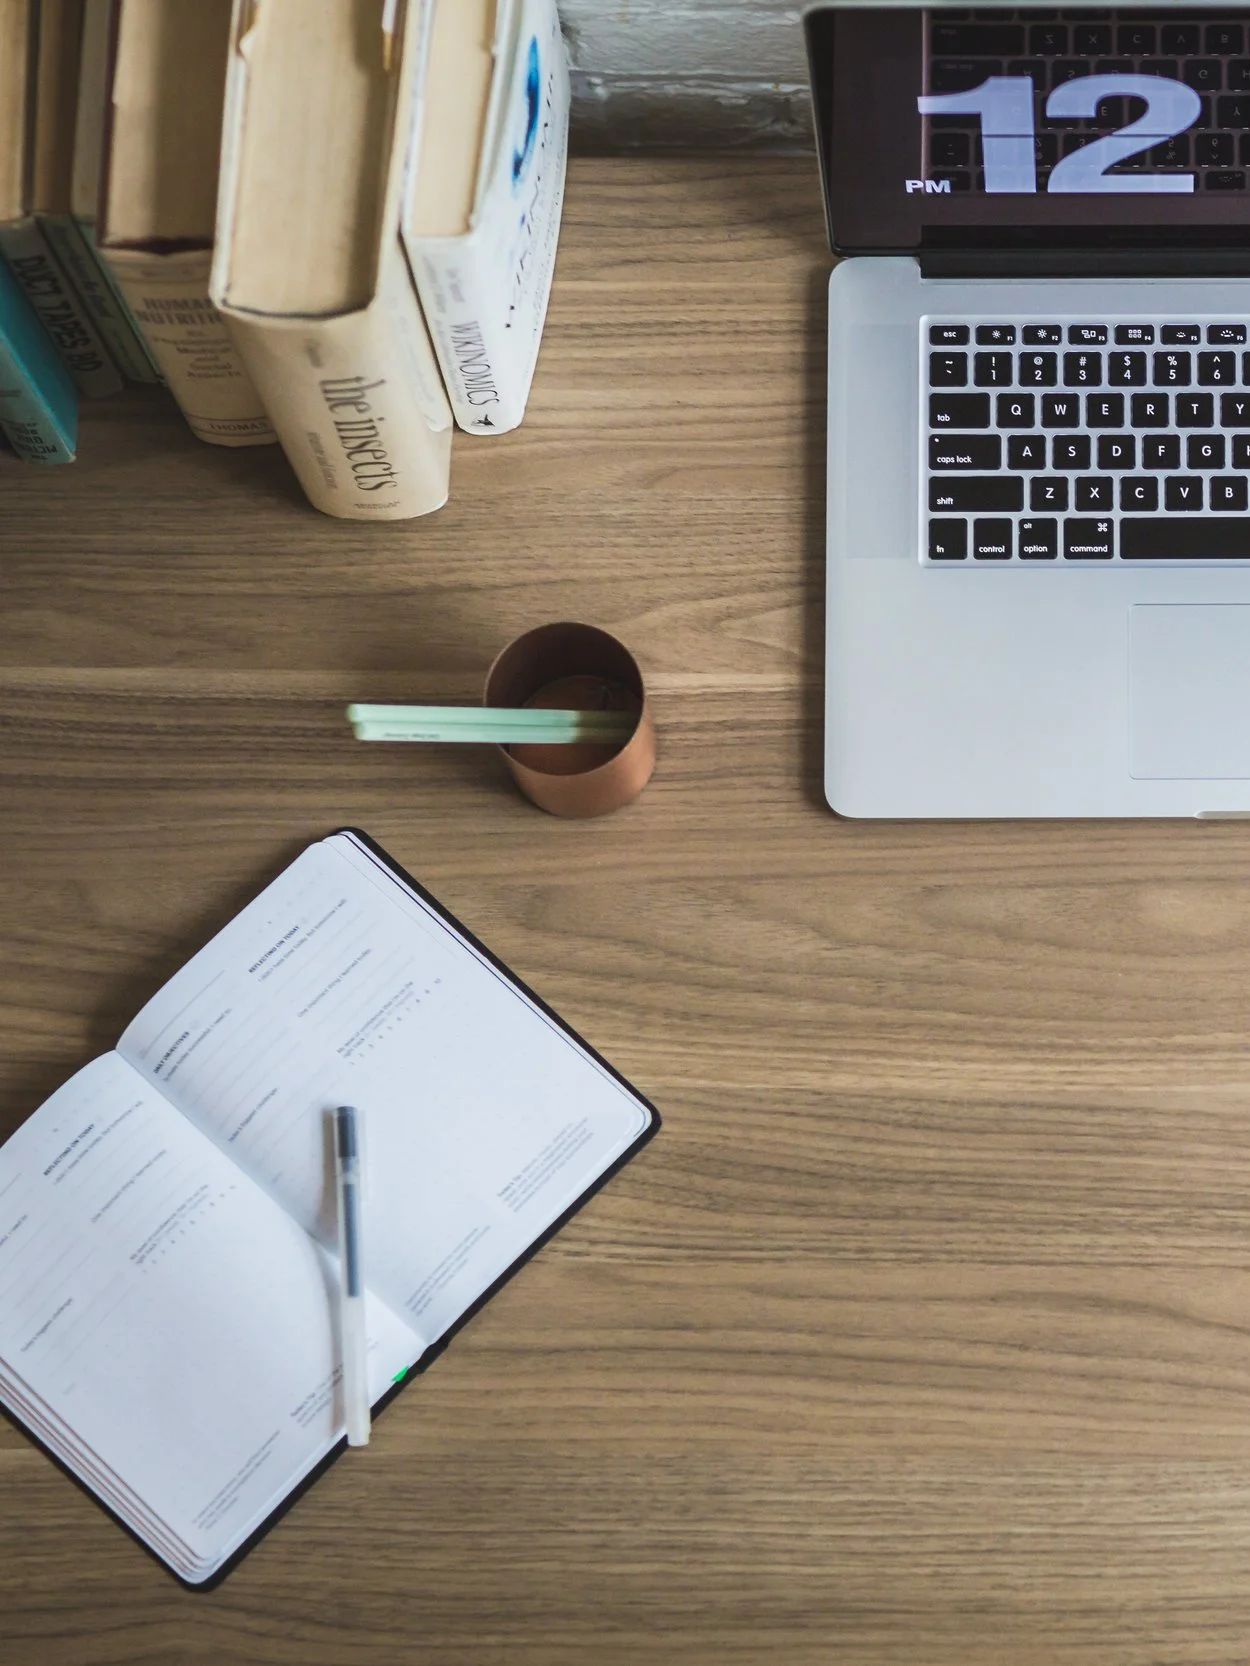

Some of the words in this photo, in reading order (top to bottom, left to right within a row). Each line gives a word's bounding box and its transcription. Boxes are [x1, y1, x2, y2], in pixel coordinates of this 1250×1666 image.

[917, 75, 1202, 193] 12
[905, 179, 951, 193] PM
[38, 298, 91, 350] TAPES
[449, 320, 501, 408] WIKINOMICS
[991, 356, 996, 367] !
[1033, 356, 1044, 366] @
[1079, 356, 1087, 367] #
[1123, 355, 1131, 367] $
[1167, 355, 1178, 366] %
[990, 369, 996, 381] 1
[1034, 369, 1043, 381] 2
[1078, 369, 1087, 381] 3
[1123, 369, 1132, 380] 4
[1168, 369, 1177, 380] 5
[1213, 369, 1221, 380] 6
[320, 375, 386, 413] the
[936, 413, 951, 422] tab
[1010, 403, 1022, 416] Q
[1054, 403, 1067, 416] W
[1101, 403, 1109, 416] E
[1146, 403, 1155, 416] R
[1191, 403, 1199, 415] T
[1235, 403, 1245, 415] Y
[334, 415, 399, 493] insects
[936, 455, 955, 465] caps
[956, 455, 973, 464] lock
[1022, 445, 1033, 457] A
[1068, 445, 1077, 457] S
[1112, 445, 1122, 457] D
[1158, 445, 1166, 457] F
[1201, 445, 1212, 457] G
[936, 496, 954, 505] shift
[1045, 487, 1055, 499] Z
[1089, 487, 1100, 499] X
[1134, 486, 1145, 499] C
[1179, 487, 1190, 499] V
[1225, 486, 1234, 499] B
[935, 544, 945, 553] fn
[978, 544, 1006, 554] control
[1023, 544, 1048, 554] option
[1069, 544, 1109, 553] command
